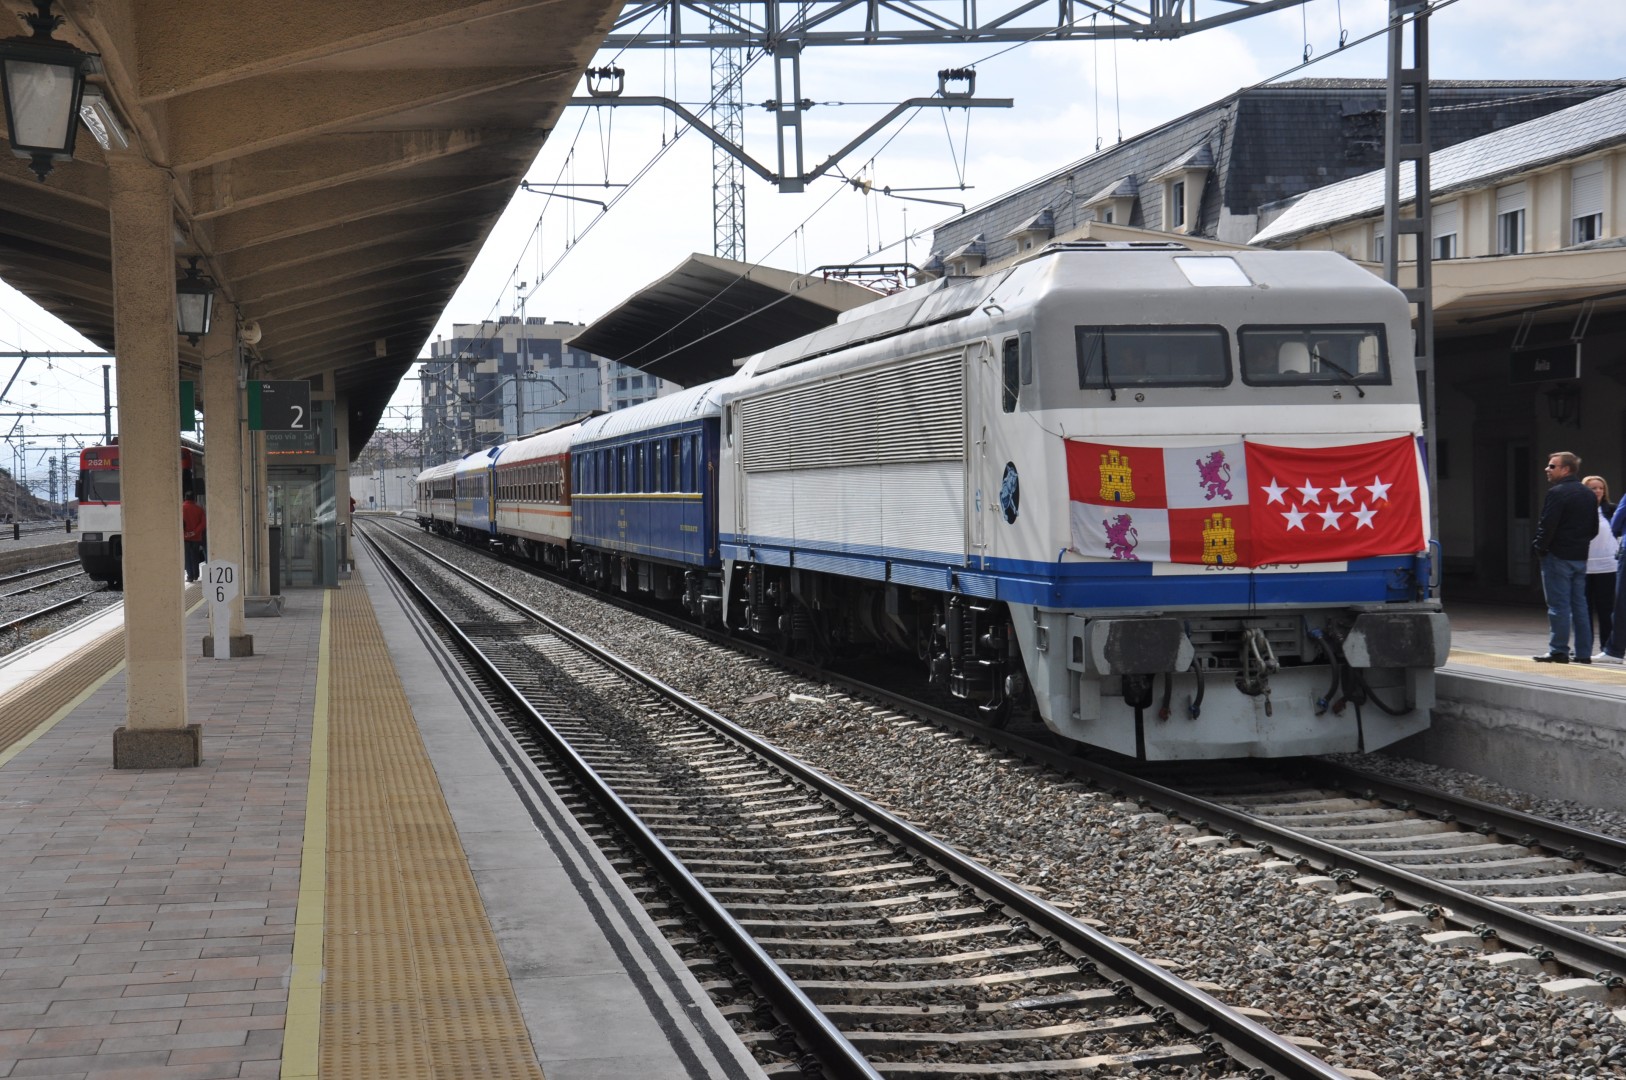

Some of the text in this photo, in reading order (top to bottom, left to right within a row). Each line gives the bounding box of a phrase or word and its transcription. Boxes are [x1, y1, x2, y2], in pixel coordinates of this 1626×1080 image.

[290, 405, 304, 428] 2
[209, 566, 233, 584] 120
[216, 586, 225, 603] 6
